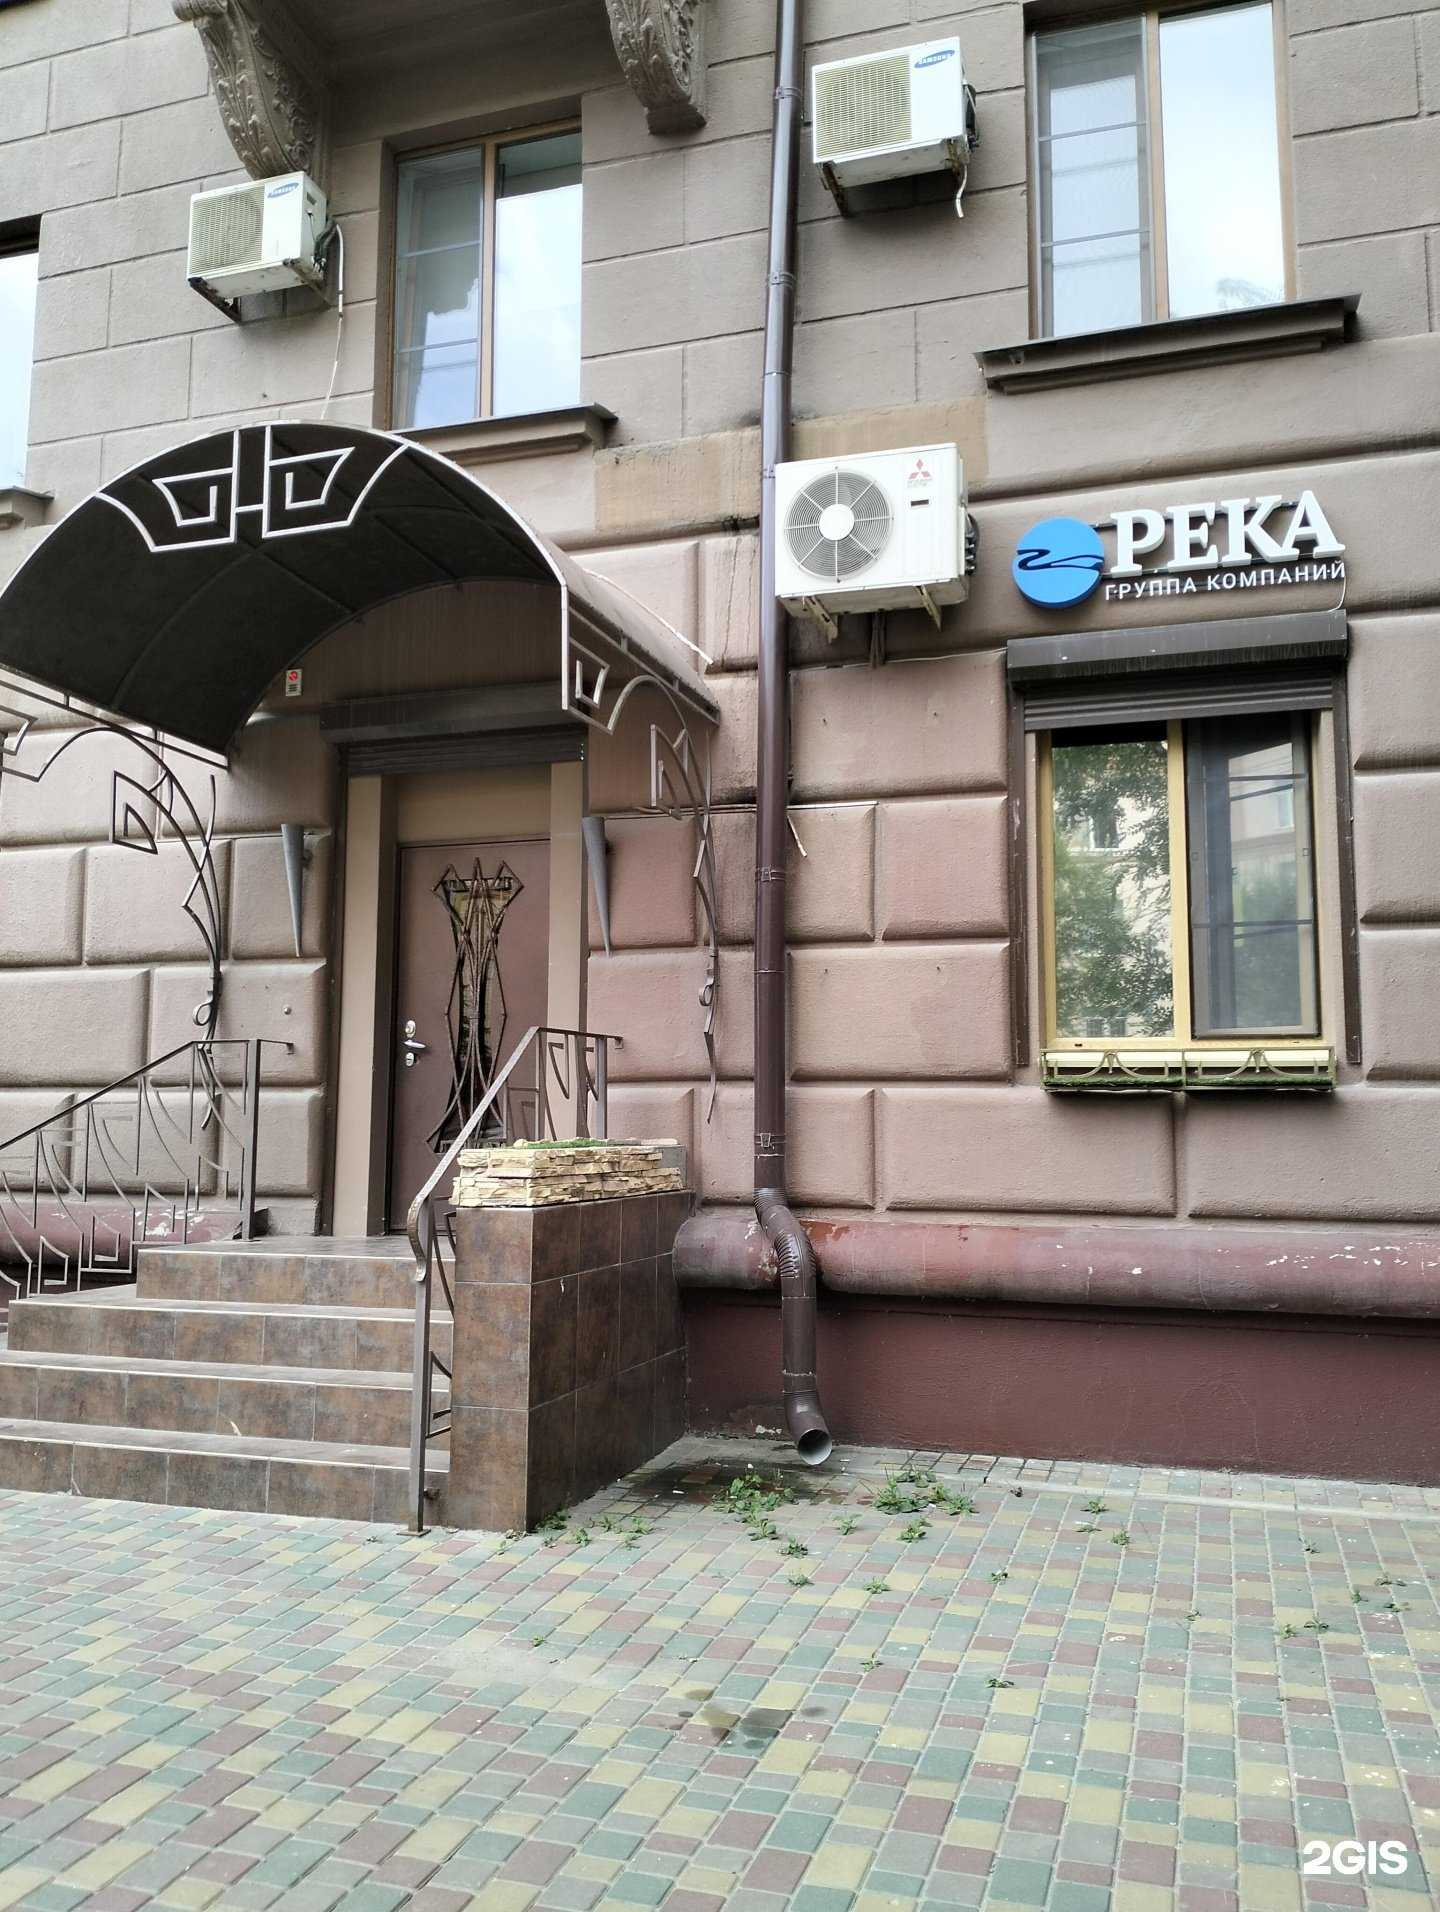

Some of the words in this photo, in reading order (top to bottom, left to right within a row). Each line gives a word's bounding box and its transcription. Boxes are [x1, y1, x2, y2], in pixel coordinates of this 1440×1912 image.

[1110, 490, 1346, 578] РЕКА
[1105, 577, 1198, 600] ГРУППА
[1207, 560, 1346, 591] КОМПАНИЙ
